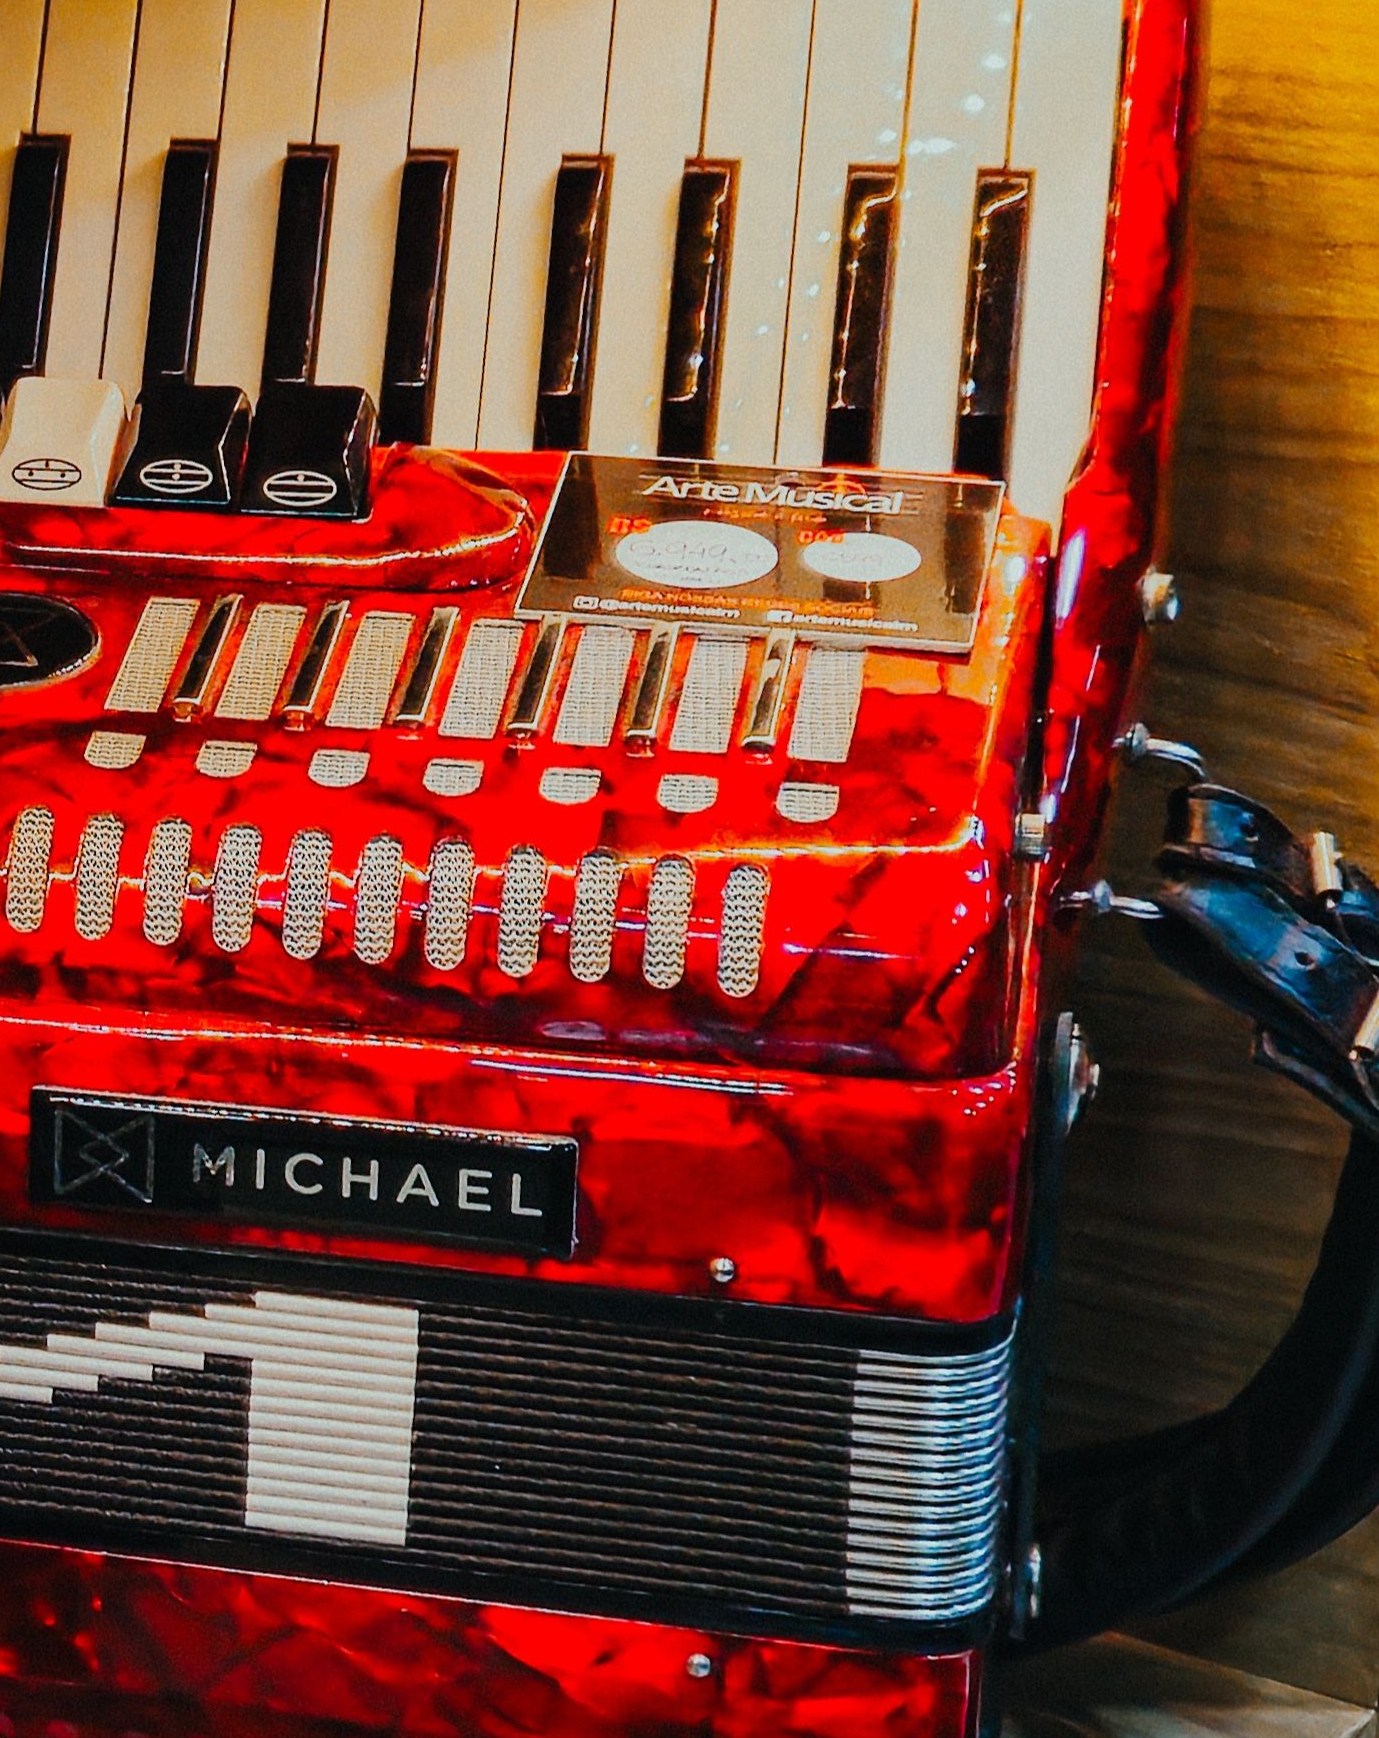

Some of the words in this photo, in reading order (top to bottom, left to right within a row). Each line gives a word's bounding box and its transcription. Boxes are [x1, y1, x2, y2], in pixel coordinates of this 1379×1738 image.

[641, 476, 740, 503] Arte
[744, 482, 904, 514] Musical
[193, 1143, 543, 1216] MICHAEL
